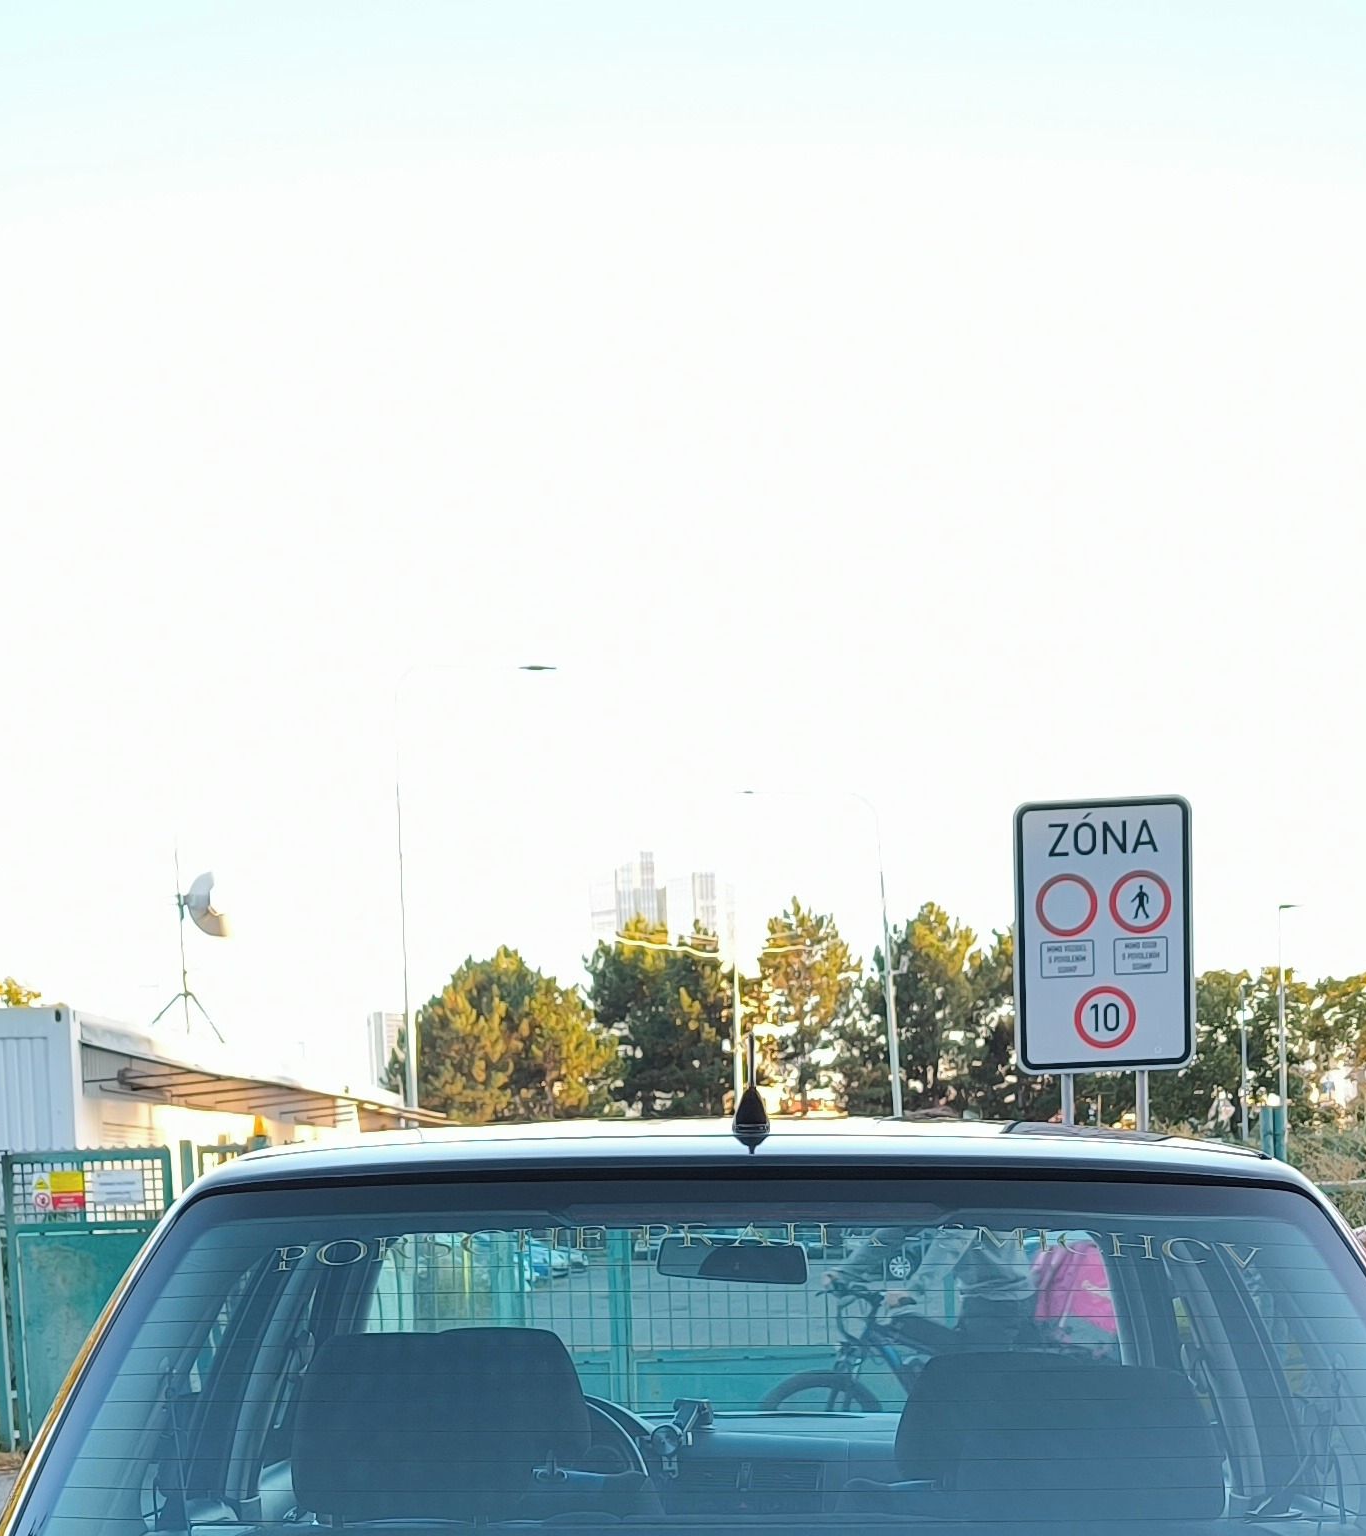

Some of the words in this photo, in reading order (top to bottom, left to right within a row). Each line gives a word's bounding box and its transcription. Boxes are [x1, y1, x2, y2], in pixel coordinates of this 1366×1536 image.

[1047, 812, 1159, 857] ZÓNA
[1089, 1002, 1120, 1032] 10
[275, 1224, 607, 1273] PORSCHE
